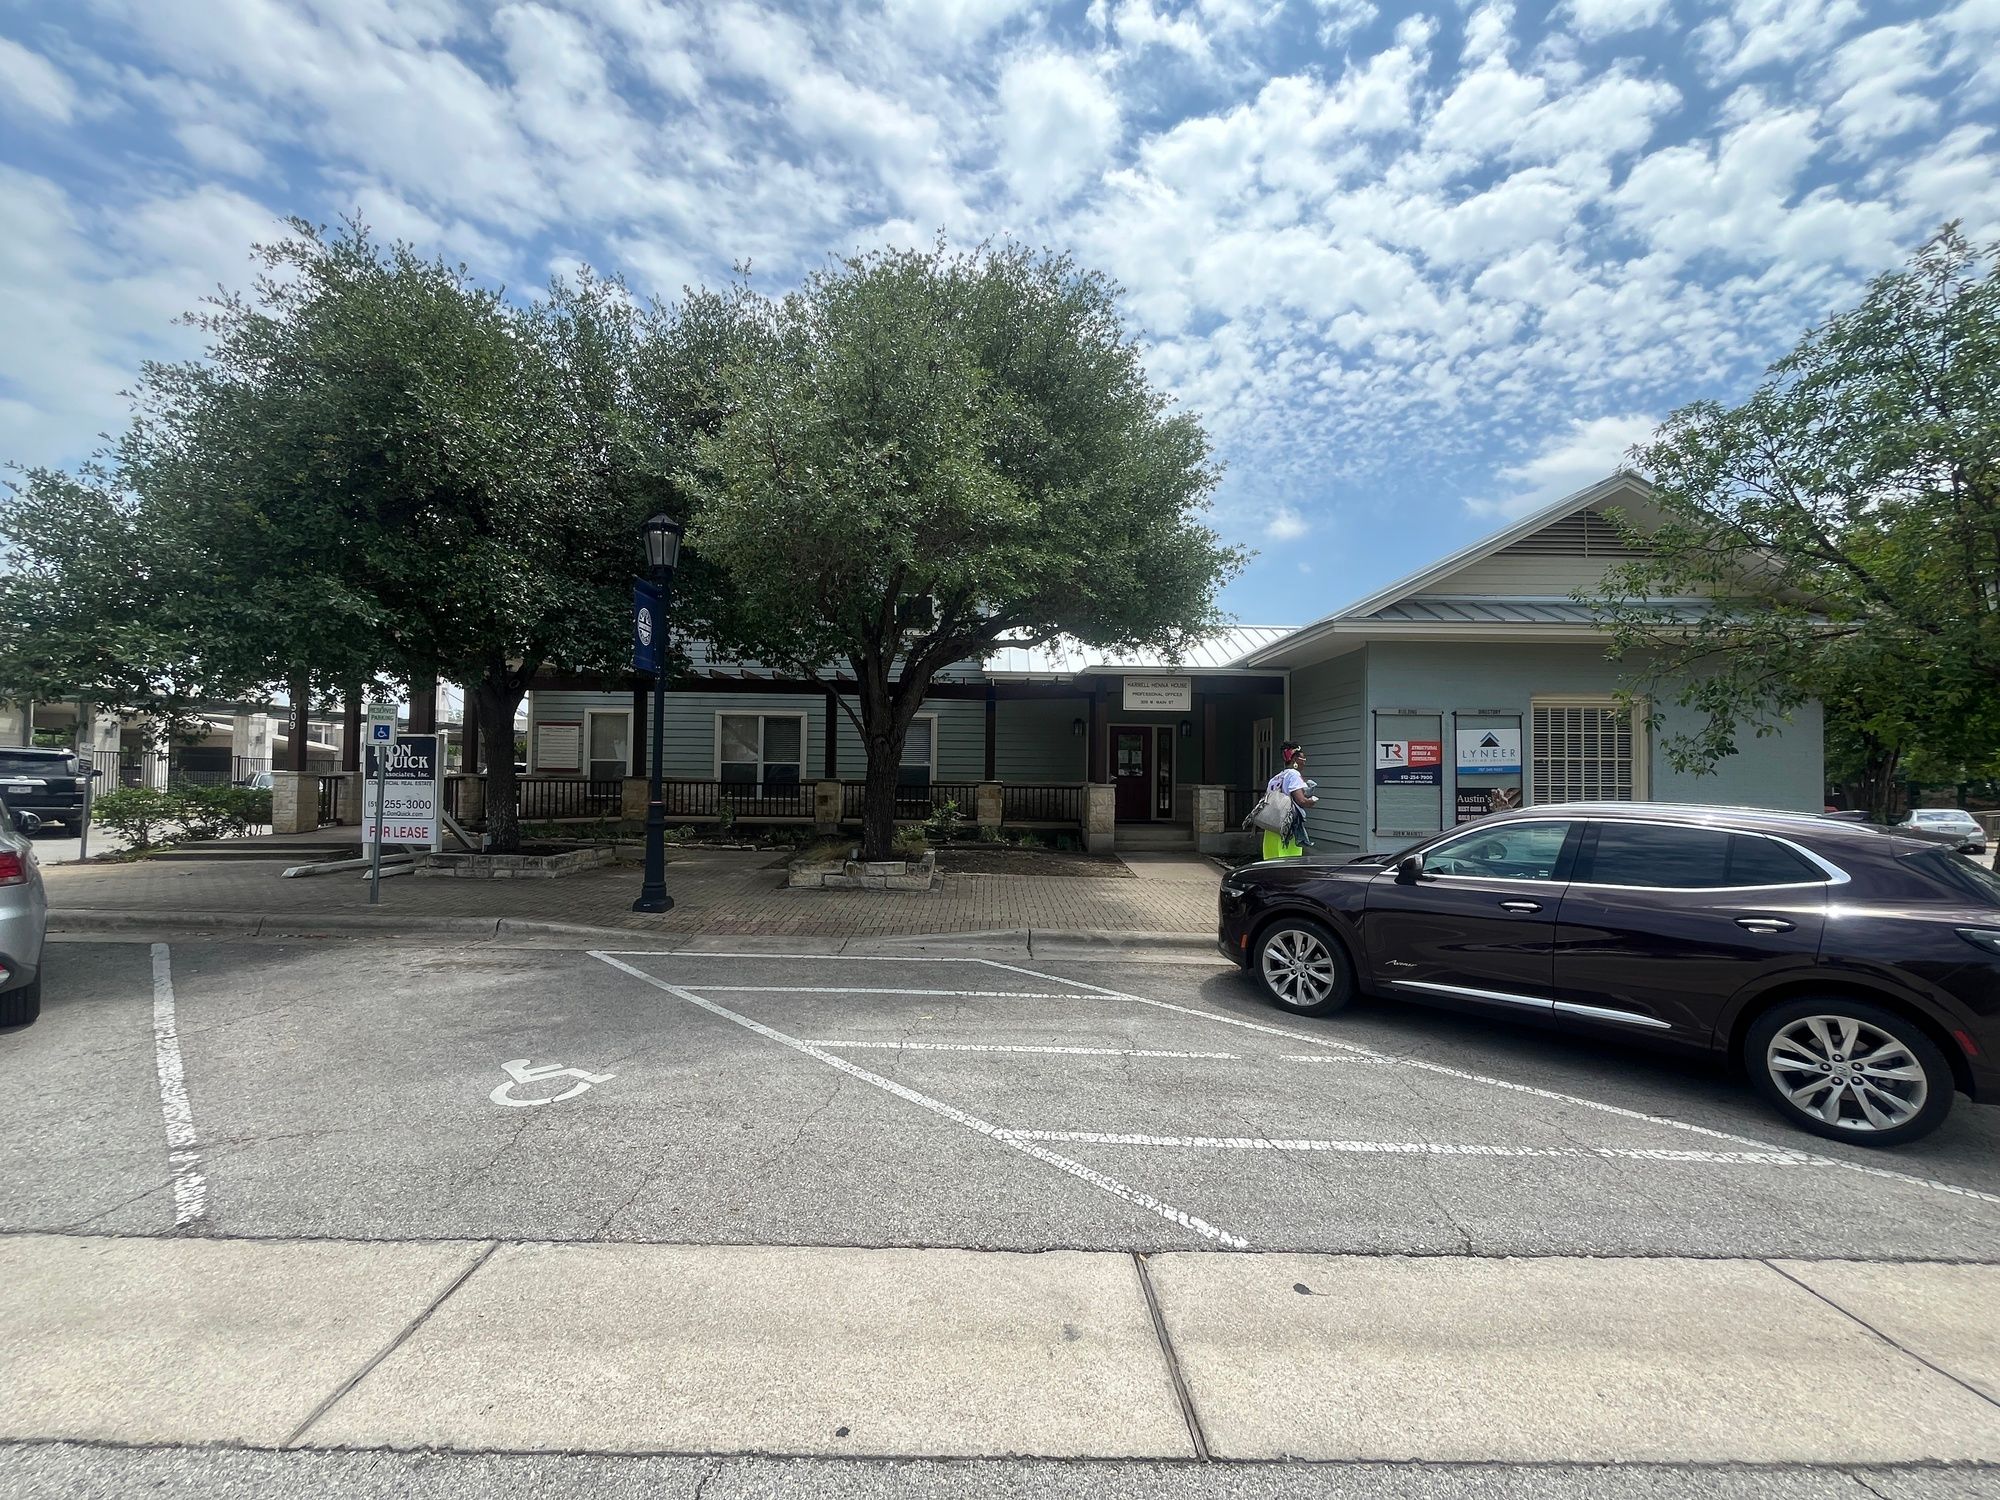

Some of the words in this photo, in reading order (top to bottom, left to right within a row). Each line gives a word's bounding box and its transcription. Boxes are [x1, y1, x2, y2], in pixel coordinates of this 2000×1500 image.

[1380, 743, 1403, 759] TR
[1462, 749, 1516, 759] LYNEER
[1457, 794, 1492, 803] Austin's
[384, 799, 432, 810] 255-3000
[369, 825, 390, 838] FR
[394, 826, 429, 839] LEASE
